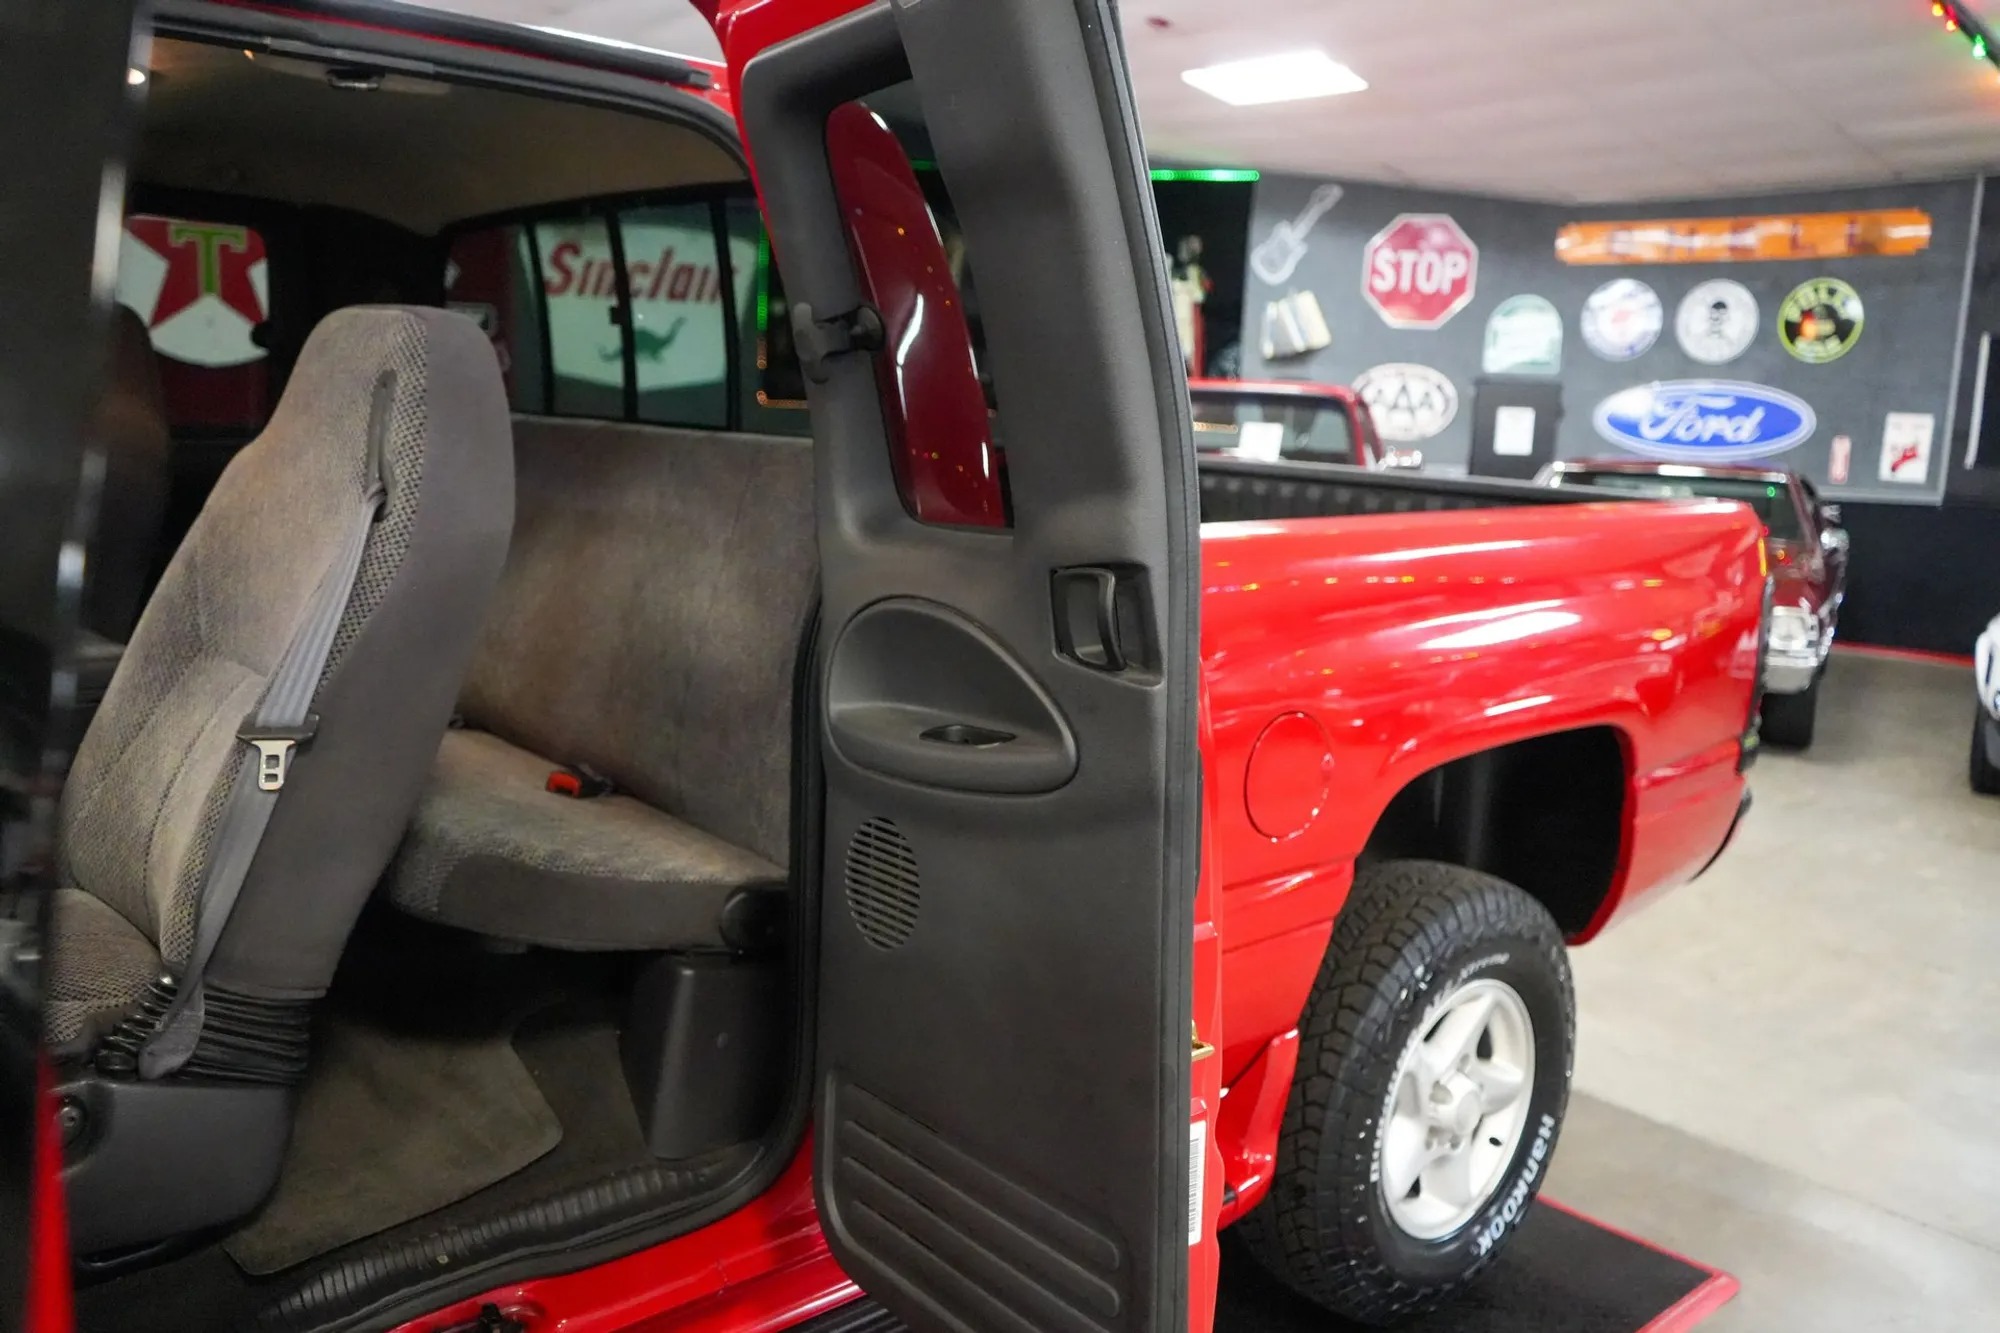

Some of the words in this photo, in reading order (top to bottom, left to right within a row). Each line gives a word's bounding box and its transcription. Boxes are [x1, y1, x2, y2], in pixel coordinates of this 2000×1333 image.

[168, 223, 247, 296] T
[1371, 247, 1468, 295] STOP
[1638, 395, 1766, 443] Ford
